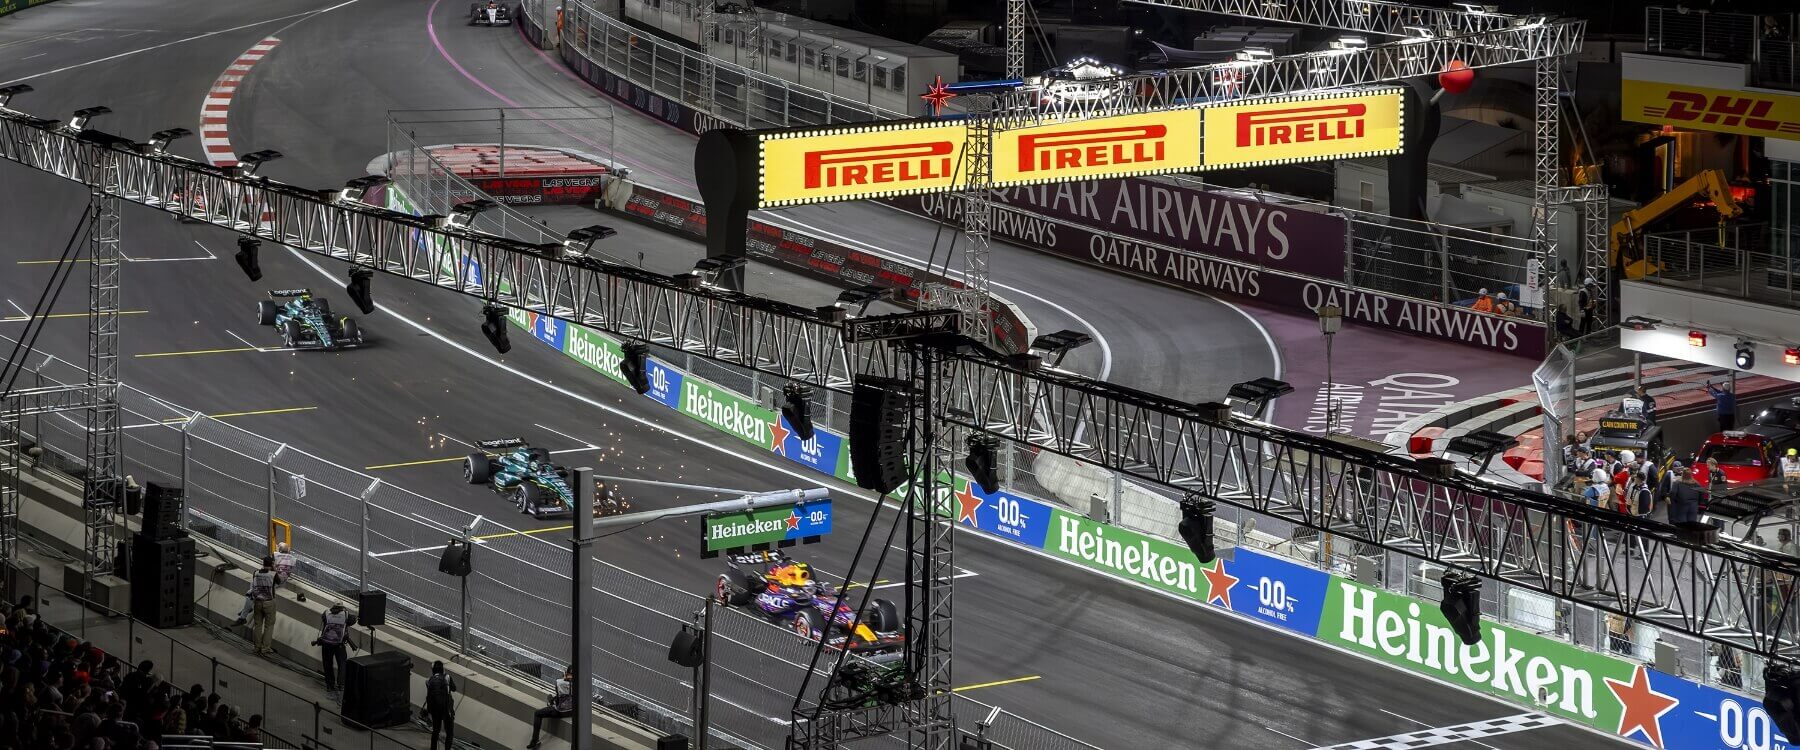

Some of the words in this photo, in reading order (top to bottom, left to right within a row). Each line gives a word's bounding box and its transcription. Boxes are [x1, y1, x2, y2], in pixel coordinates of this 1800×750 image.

[1236, 103, 1366, 147] PIRELLI
[1664, 90, 1782, 131] DHL
[804, 141, 954, 189] PIRELLI
[1018, 124, 1167, 172] PIRELLI
[542, 178, 563, 188] LAS
[565, 177, 600, 187] VEGAS
[1111, 180, 1290, 260] AIRWAYS
[1089, 234, 1159, 274] QATAR
[1163, 252, 1261, 297] AIRWAYS
[1397, 301, 1518, 351] AIRWAYS
[686, 381, 766, 444] Heineken
[711, 519, 783, 540] Heineken
[1058, 515, 1198, 593] Heineken
[1339, 582, 1598, 719] Heineken
